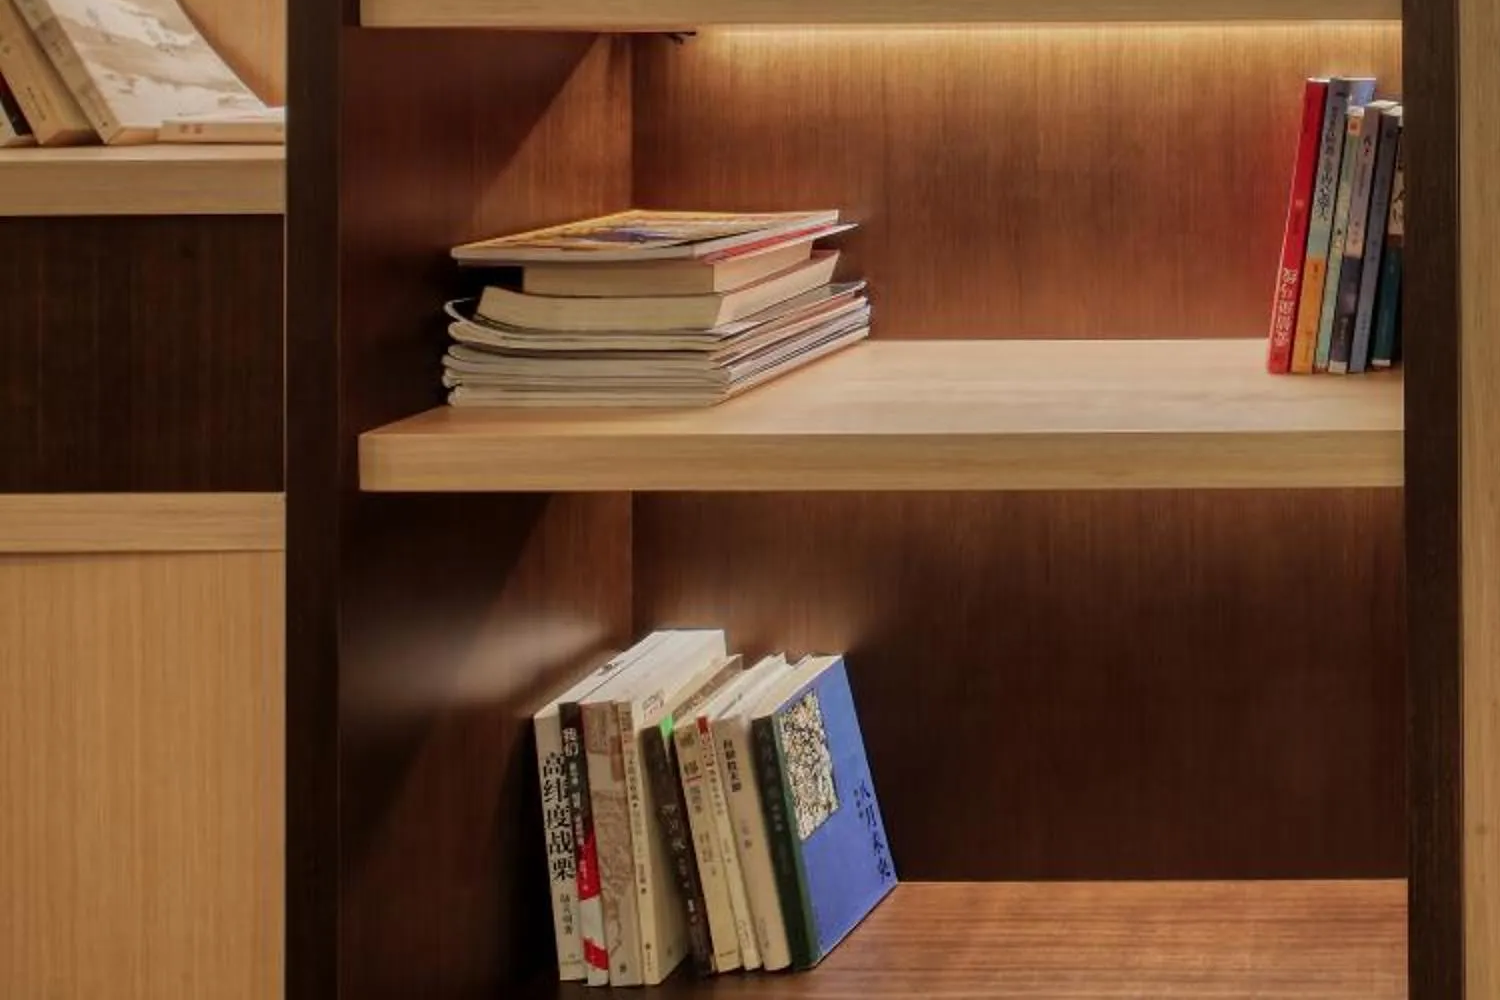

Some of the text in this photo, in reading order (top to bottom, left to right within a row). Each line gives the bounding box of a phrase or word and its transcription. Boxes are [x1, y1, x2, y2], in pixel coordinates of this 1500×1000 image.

[543, 751, 577, 881] 高纬度战栗
